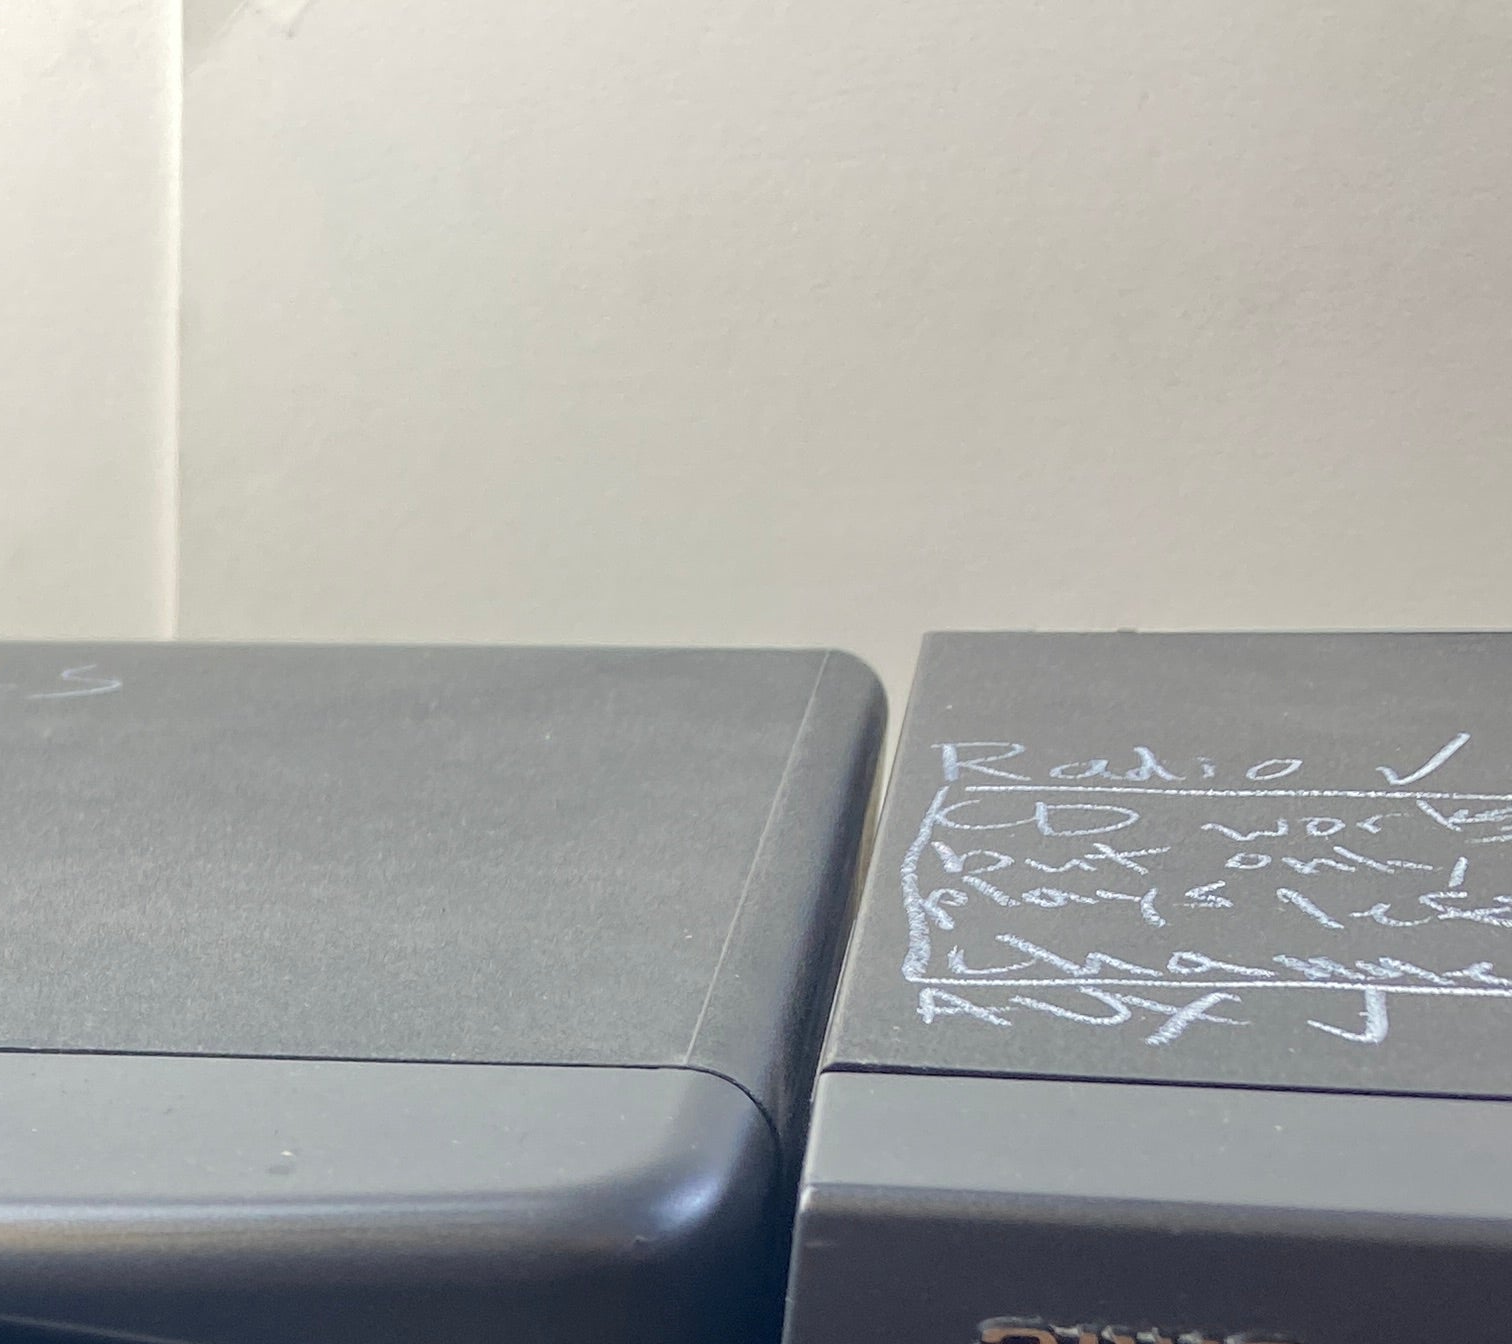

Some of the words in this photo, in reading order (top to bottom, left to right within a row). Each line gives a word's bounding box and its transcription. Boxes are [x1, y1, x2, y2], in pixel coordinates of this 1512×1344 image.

[931, 741, 1303, 781] Radio
[936, 799, 1139, 836] CD
[931, 841, 1172, 875] but
